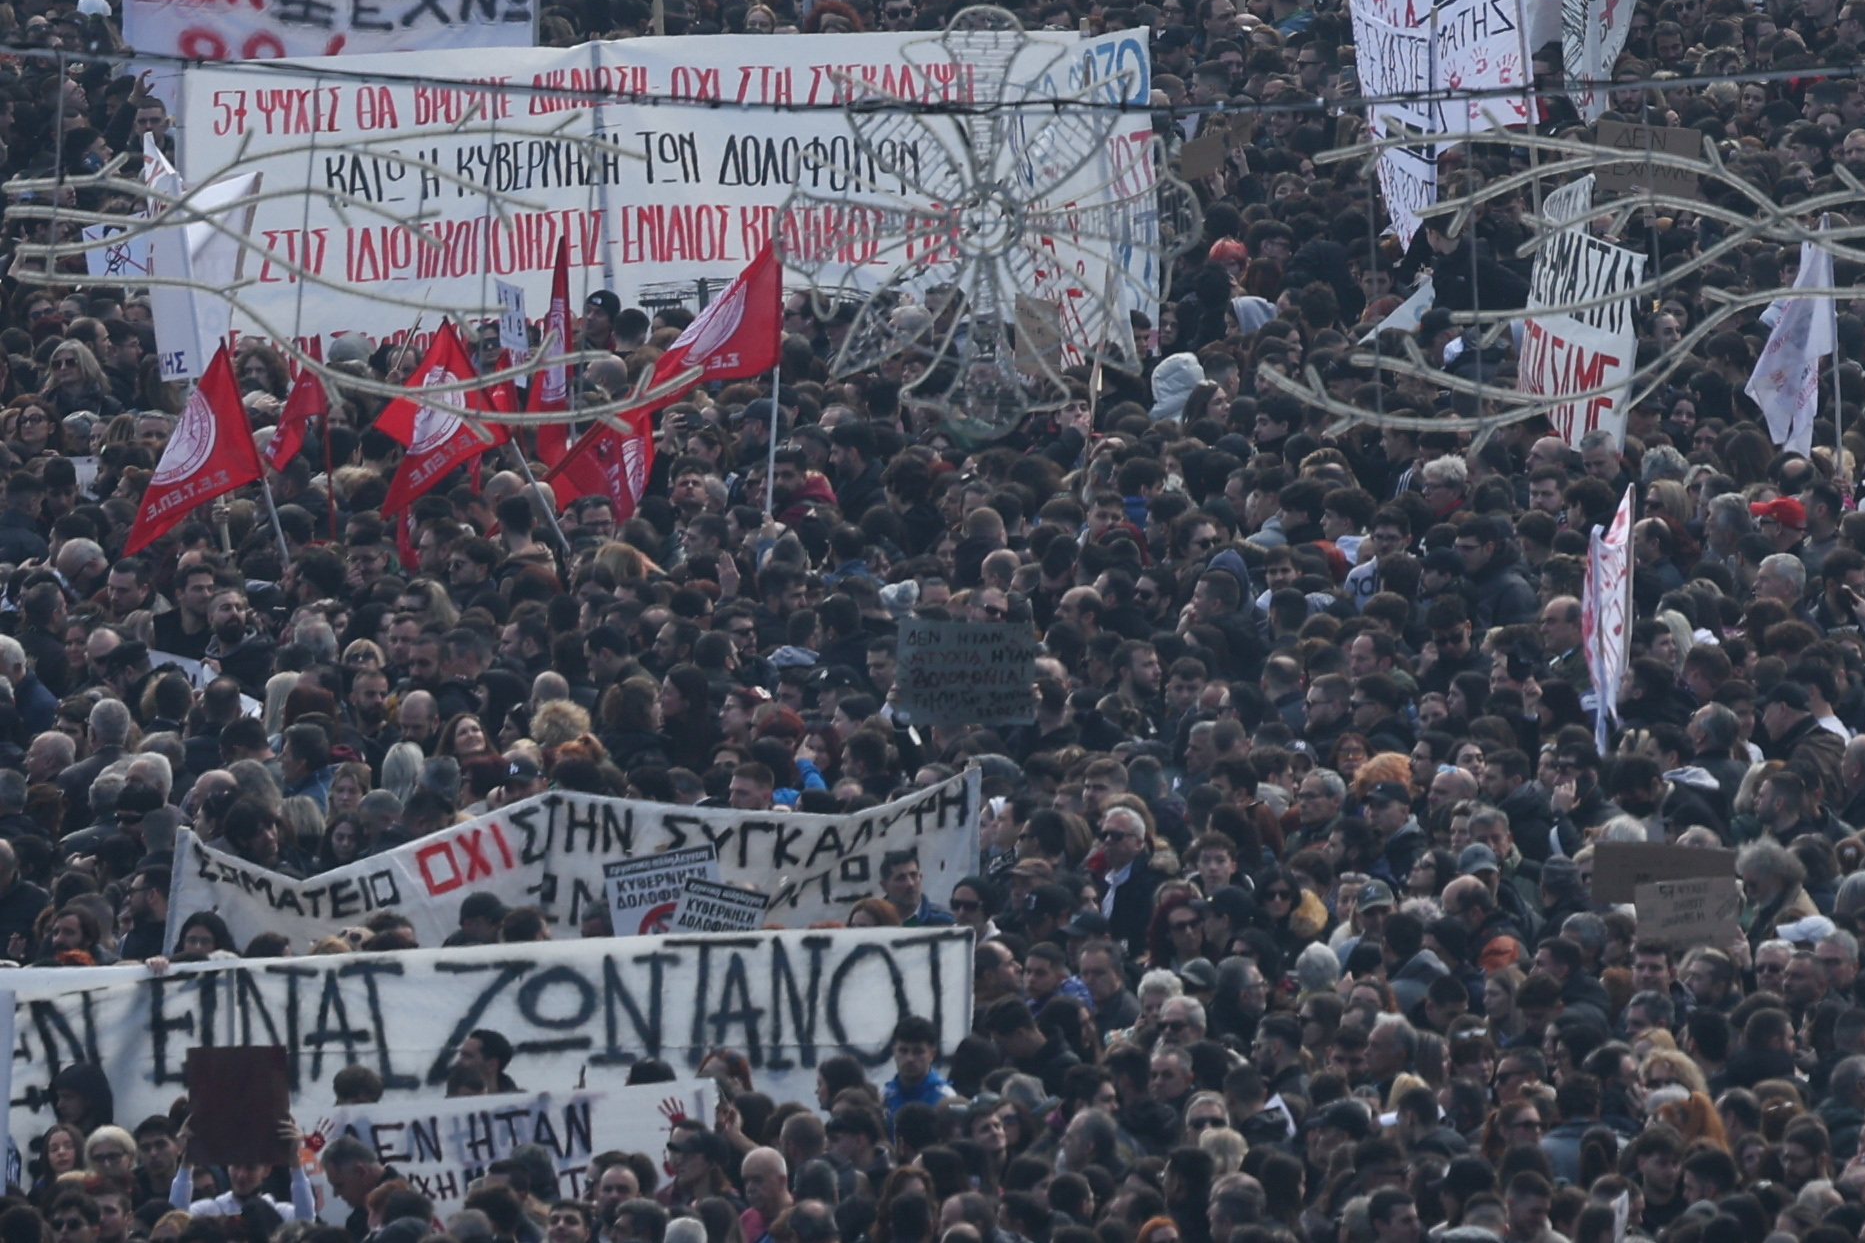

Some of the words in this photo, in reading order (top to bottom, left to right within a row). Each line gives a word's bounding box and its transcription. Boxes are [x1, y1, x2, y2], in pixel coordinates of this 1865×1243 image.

[213, 88, 247, 136] 57
[256, 85, 341, 136] ΨΥΧΕΣ
[356, 85, 398, 132] ΘΑ
[670, 64, 721, 106] ΟΧΙ
[736, 64, 793, 107] ΣΤΗ
[639, 129, 703, 181] ΤΩΝ
[1613, 127, 1667, 151] ΔΕΝ
[260, 227, 330, 283] ΣΤΙΣ
[414, 822, 515, 896] ΟΧΙ
[509, 794, 635, 864] ΣΤΗΝ
[428, 936, 963, 1089] ΖΩΝΤΑΝΟΙ
[467, 1103, 595, 1163] ΗΤΑΝ
